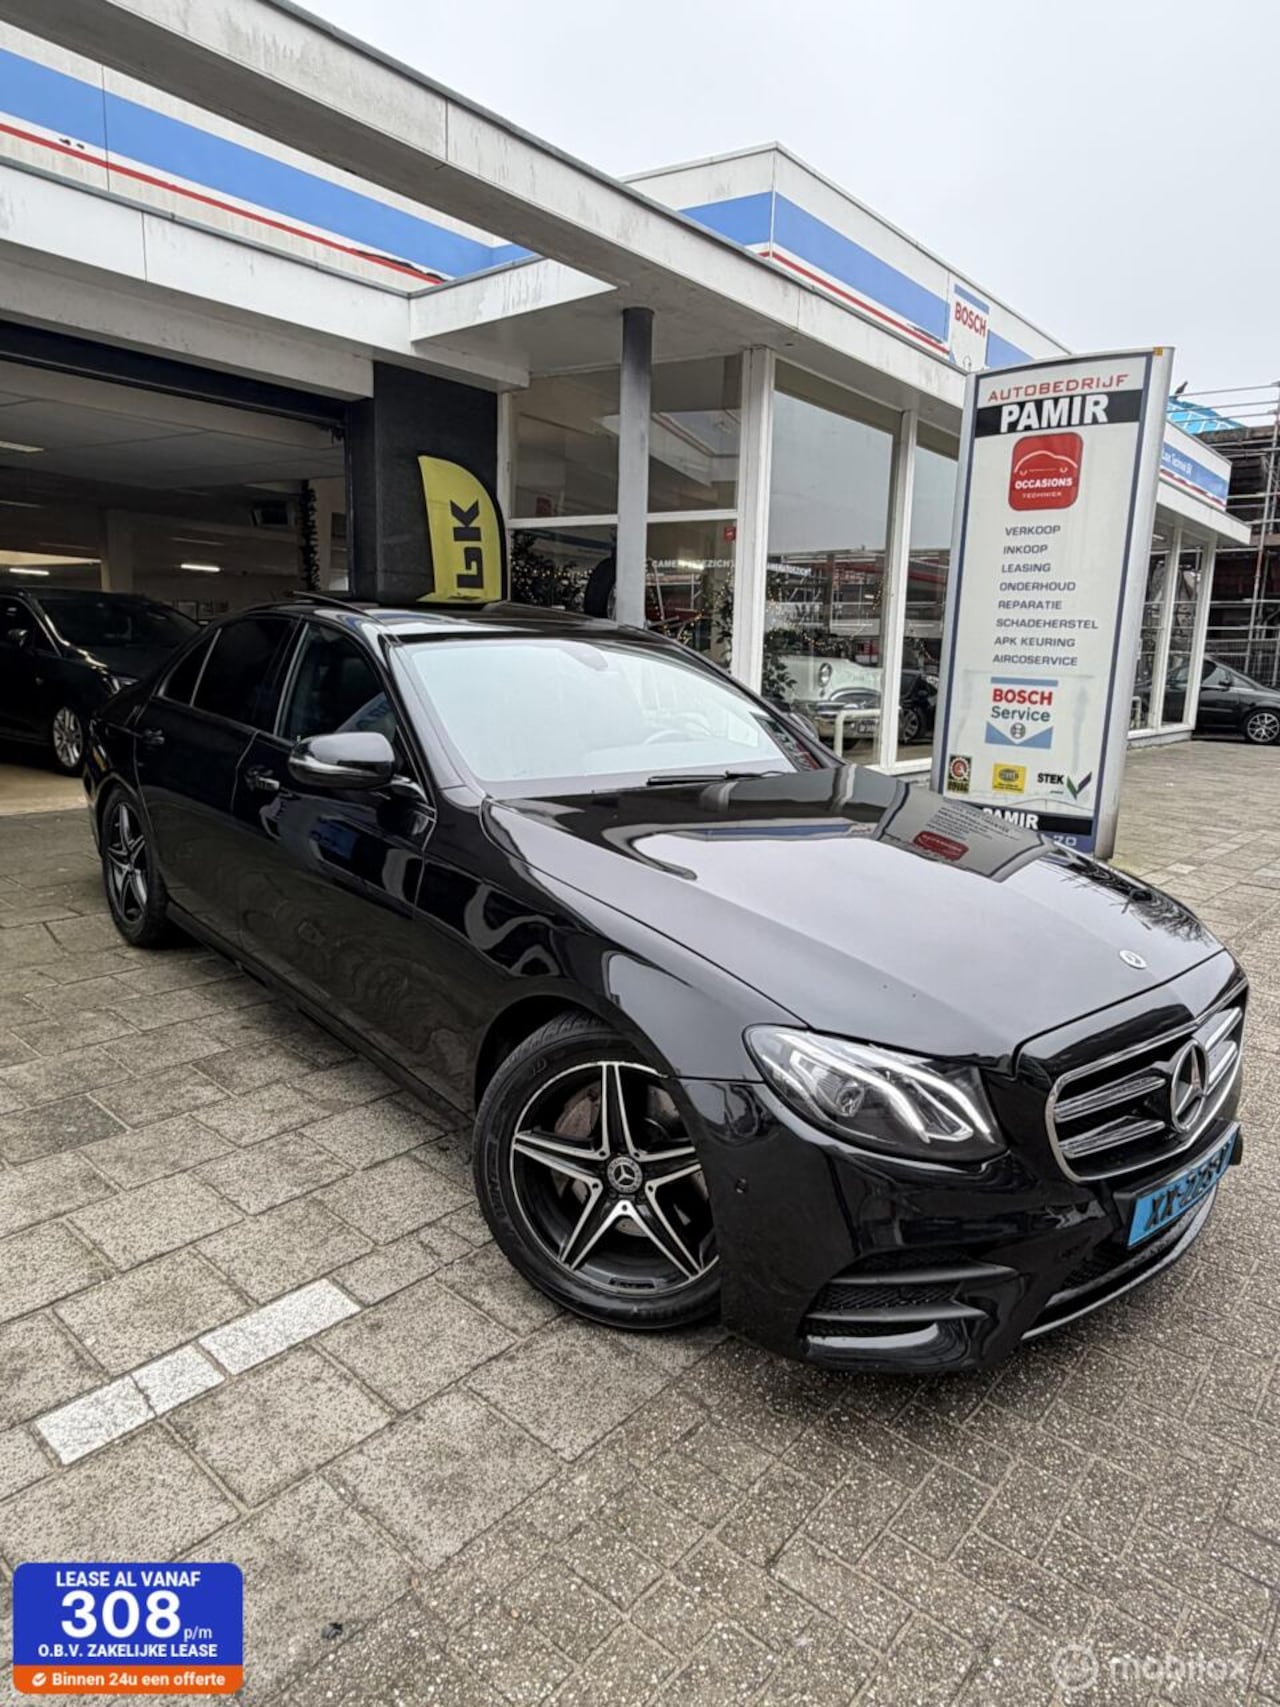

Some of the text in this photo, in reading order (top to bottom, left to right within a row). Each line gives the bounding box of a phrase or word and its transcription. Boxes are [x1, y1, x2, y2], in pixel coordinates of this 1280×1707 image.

[954, 301, 987, 338] BOSCH
[988, 374, 1129, 402] AUTOBEDRIJF
[1000, 394, 1109, 433] PAMIR
[1014, 477, 1073, 490] OCCASIONS
[1004, 524, 1062, 536] VERKOOP
[1003, 544, 1049, 555] INKOOP
[1001, 562, 1052, 573] LEASING
[999, 581, 1077, 592] ONDERHOUD
[997, 600, 1063, 610] REPARATIE
[995, 618, 1099, 629] SCHADEHERSTEL
[993, 636, 1076, 647] APK KEURING
[992, 654, 1079, 666] AIRCOSERVICE
[992, 688, 1054, 706] BOSCH
[991, 705, 1051, 722] Service
[1037, 772, 1065, 786] STEK
